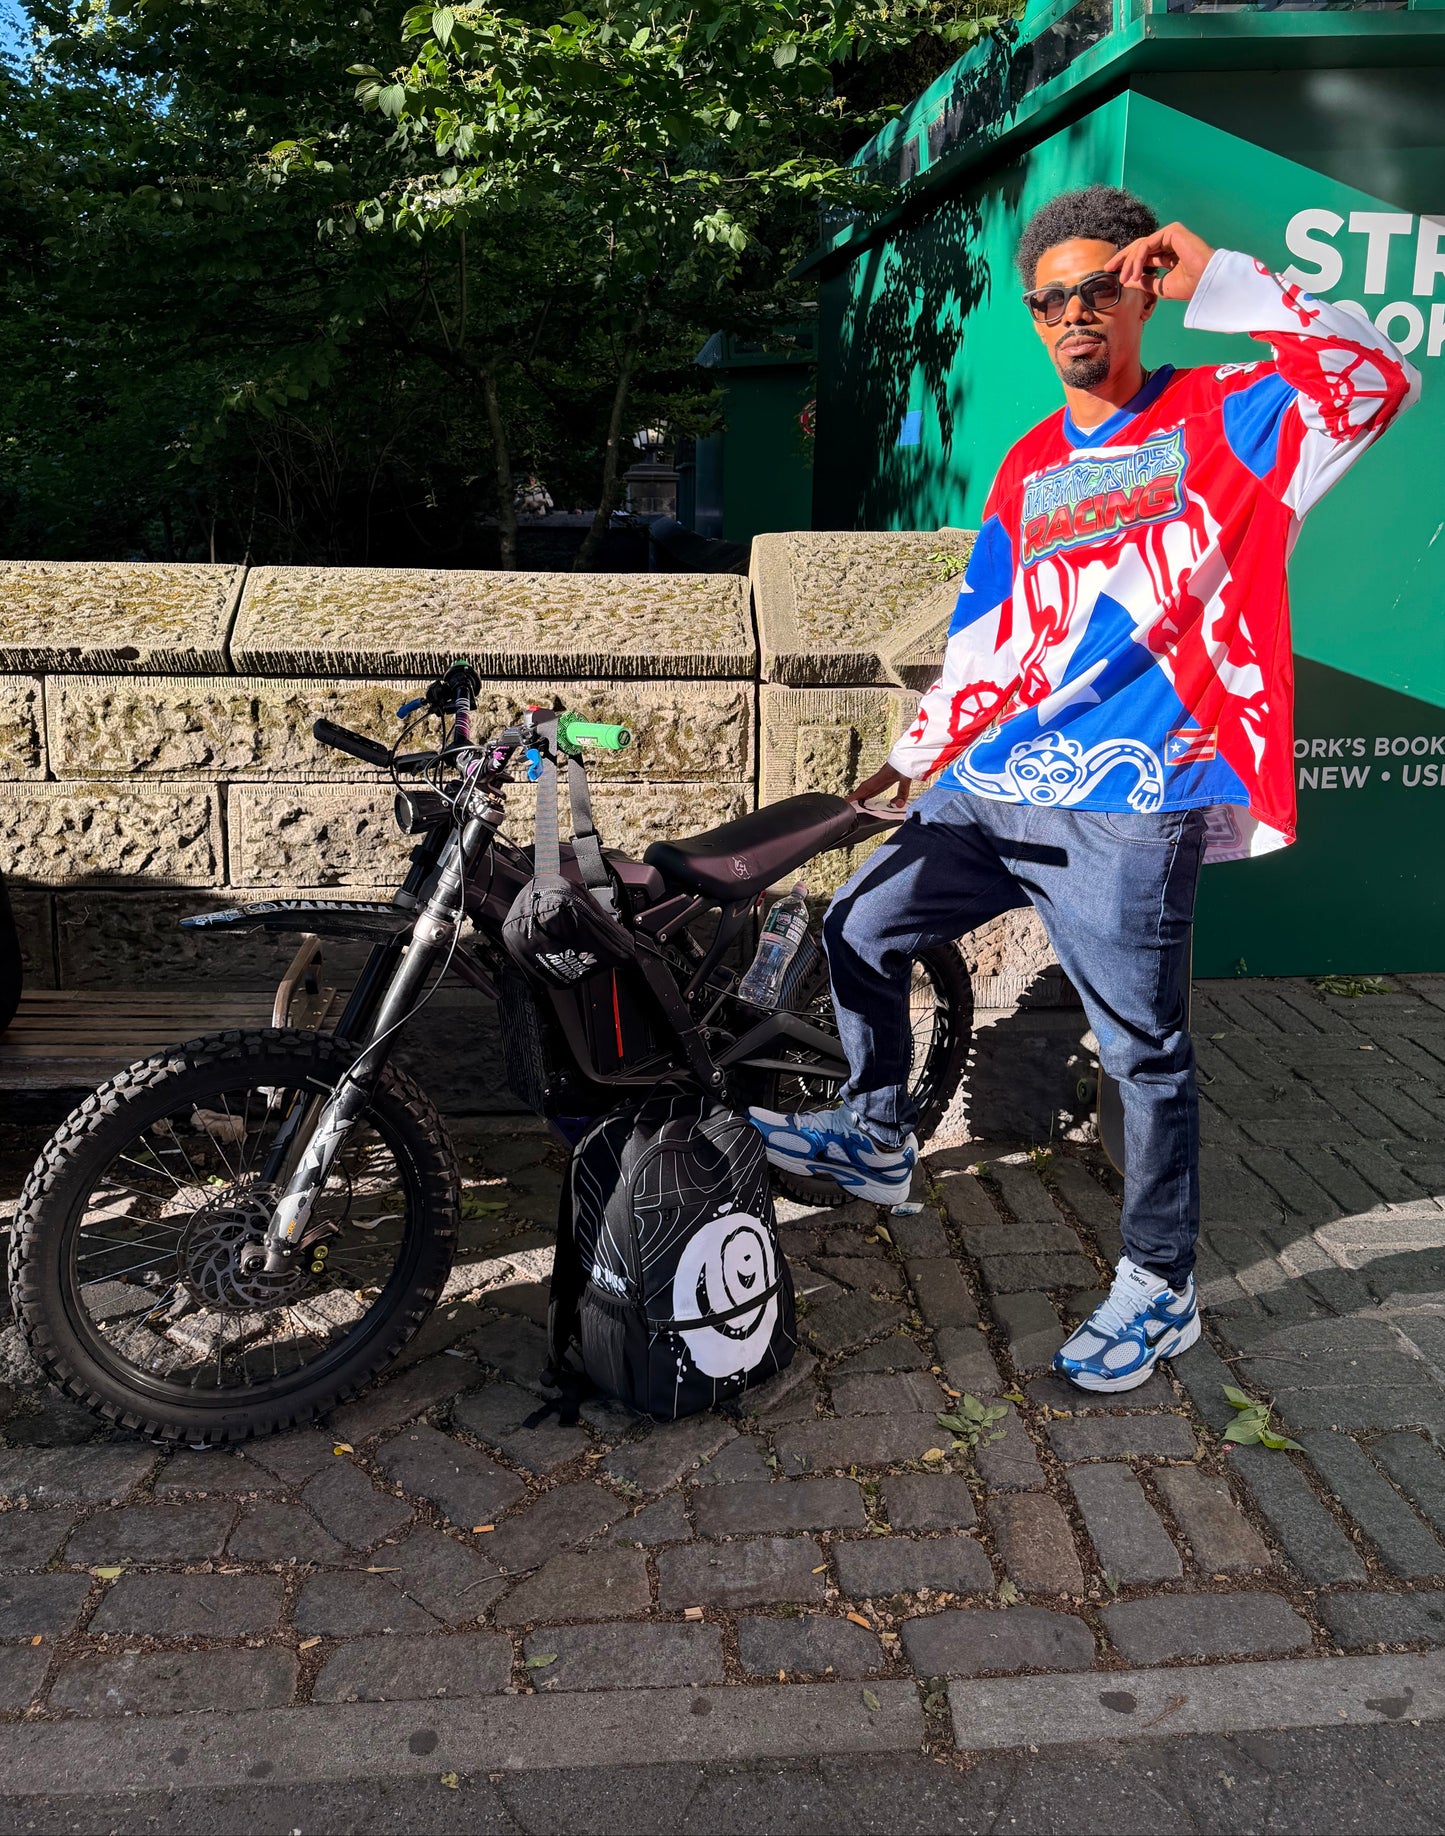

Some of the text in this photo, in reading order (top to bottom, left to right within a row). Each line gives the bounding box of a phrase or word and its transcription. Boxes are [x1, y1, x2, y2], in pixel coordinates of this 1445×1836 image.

[1024, 475, 1177, 562] RACING
[1298, 763, 1445, 790] NEW US
[280, 901, 394, 914] YAMAHA
[545, 953, 581, 980] James
[1129, 1272, 1148, 1287] NIKE
